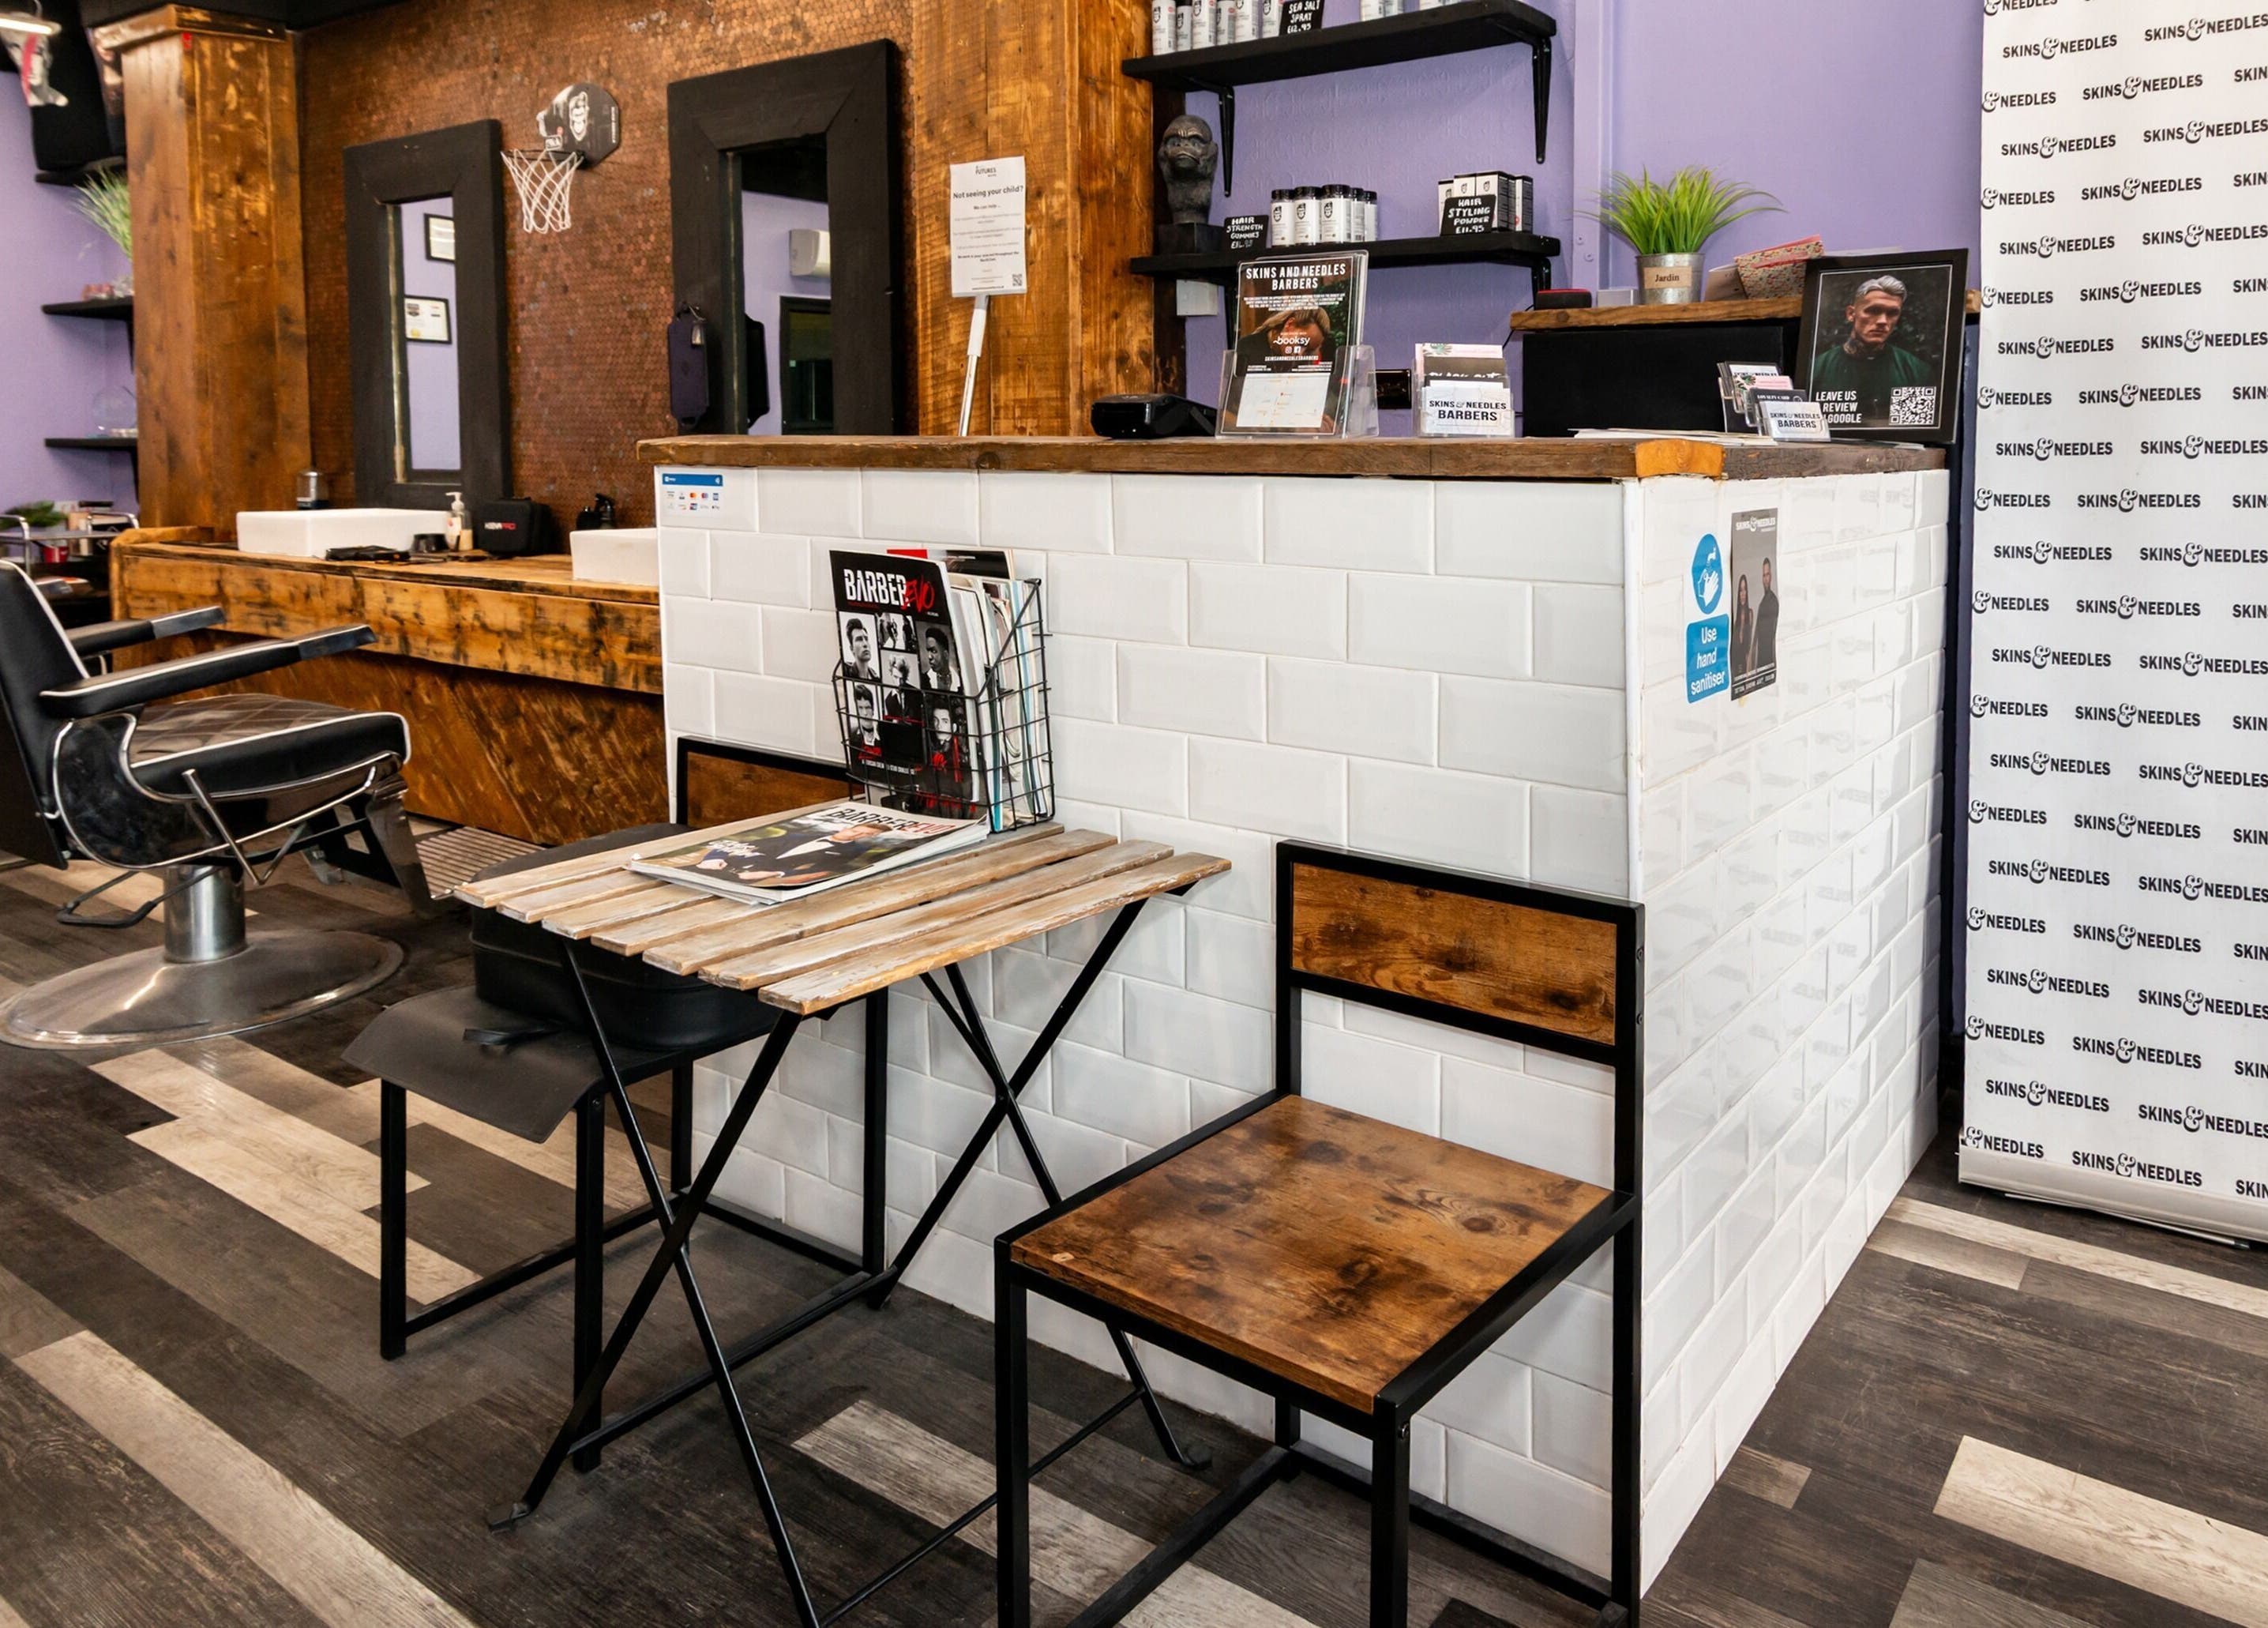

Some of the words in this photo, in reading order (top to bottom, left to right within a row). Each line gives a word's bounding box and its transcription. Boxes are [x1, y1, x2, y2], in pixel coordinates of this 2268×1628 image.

[1289, 2, 1303, 13] SEA
[1304, 0, 1320, 10] SALT
[1290, 12, 1312, 23] SPRAY
[966, 190, 986, 198] seeing
[1003, 186, 1024, 194] child?
[1458, 197, 1482, 207] HAIR
[1448, 206, 1491, 218] STYLING
[1231, 216, 1255, 225] HAIR
[1453, 216, 1490, 226] POWDER
[1226, 224, 1264, 233] STRENGTH
[1245, 267, 1278, 280] SKINS
[1279, 265, 1300, 278] AND
[1301, 263, 1346, 276] NEEDLES
[1654, 273, 1680, 283] Jardin
[1271, 277, 1319, 291] BARBERS
[1273, 336, 1311, 345] booksy
[1816, 391, 1843, 401] LEAVE
[1844, 390, 1857, 401] US
[1466, 401, 1508, 410] NEEDLES
[1823, 401, 1859, 412] REVIEW
[1437, 409, 1498, 421] BARBERS
[1827, 413, 1863, 423] GOOGLE
[1777, 420, 1817, 429] BARBERS
[1701, 626, 1717, 645] Use
[1696, 646, 1717, 670] hand
[1691, 671, 1725, 696] sanitiser
